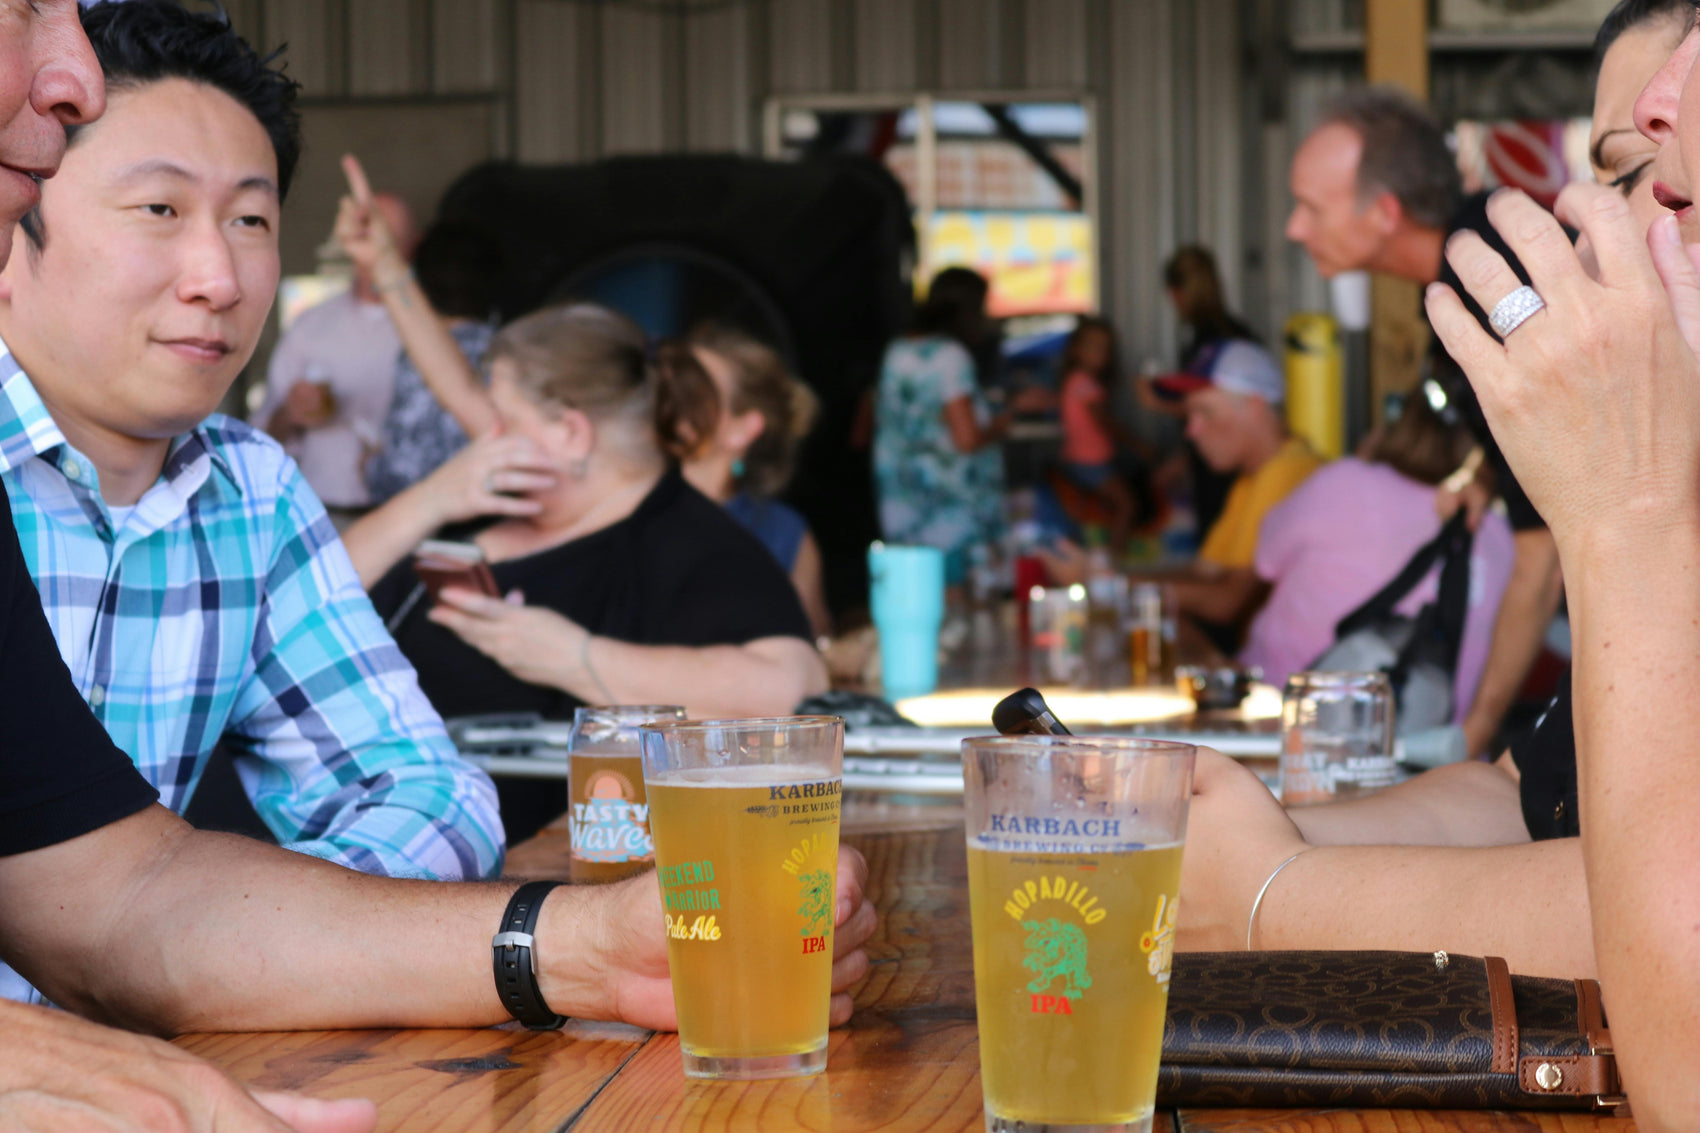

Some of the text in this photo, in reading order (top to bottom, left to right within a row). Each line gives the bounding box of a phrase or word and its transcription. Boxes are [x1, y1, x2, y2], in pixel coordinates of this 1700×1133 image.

[574, 803, 649, 822] TASTY
[783, 801, 836, 814] BREWING
[991, 814, 1121, 837] KARBACH
[1004, 876, 1107, 925] HOPADILLO
[665, 913, 722, 940] Pale Ale
[802, 935, 826, 954] IPA
[1030, 993, 1073, 1015] IPA
